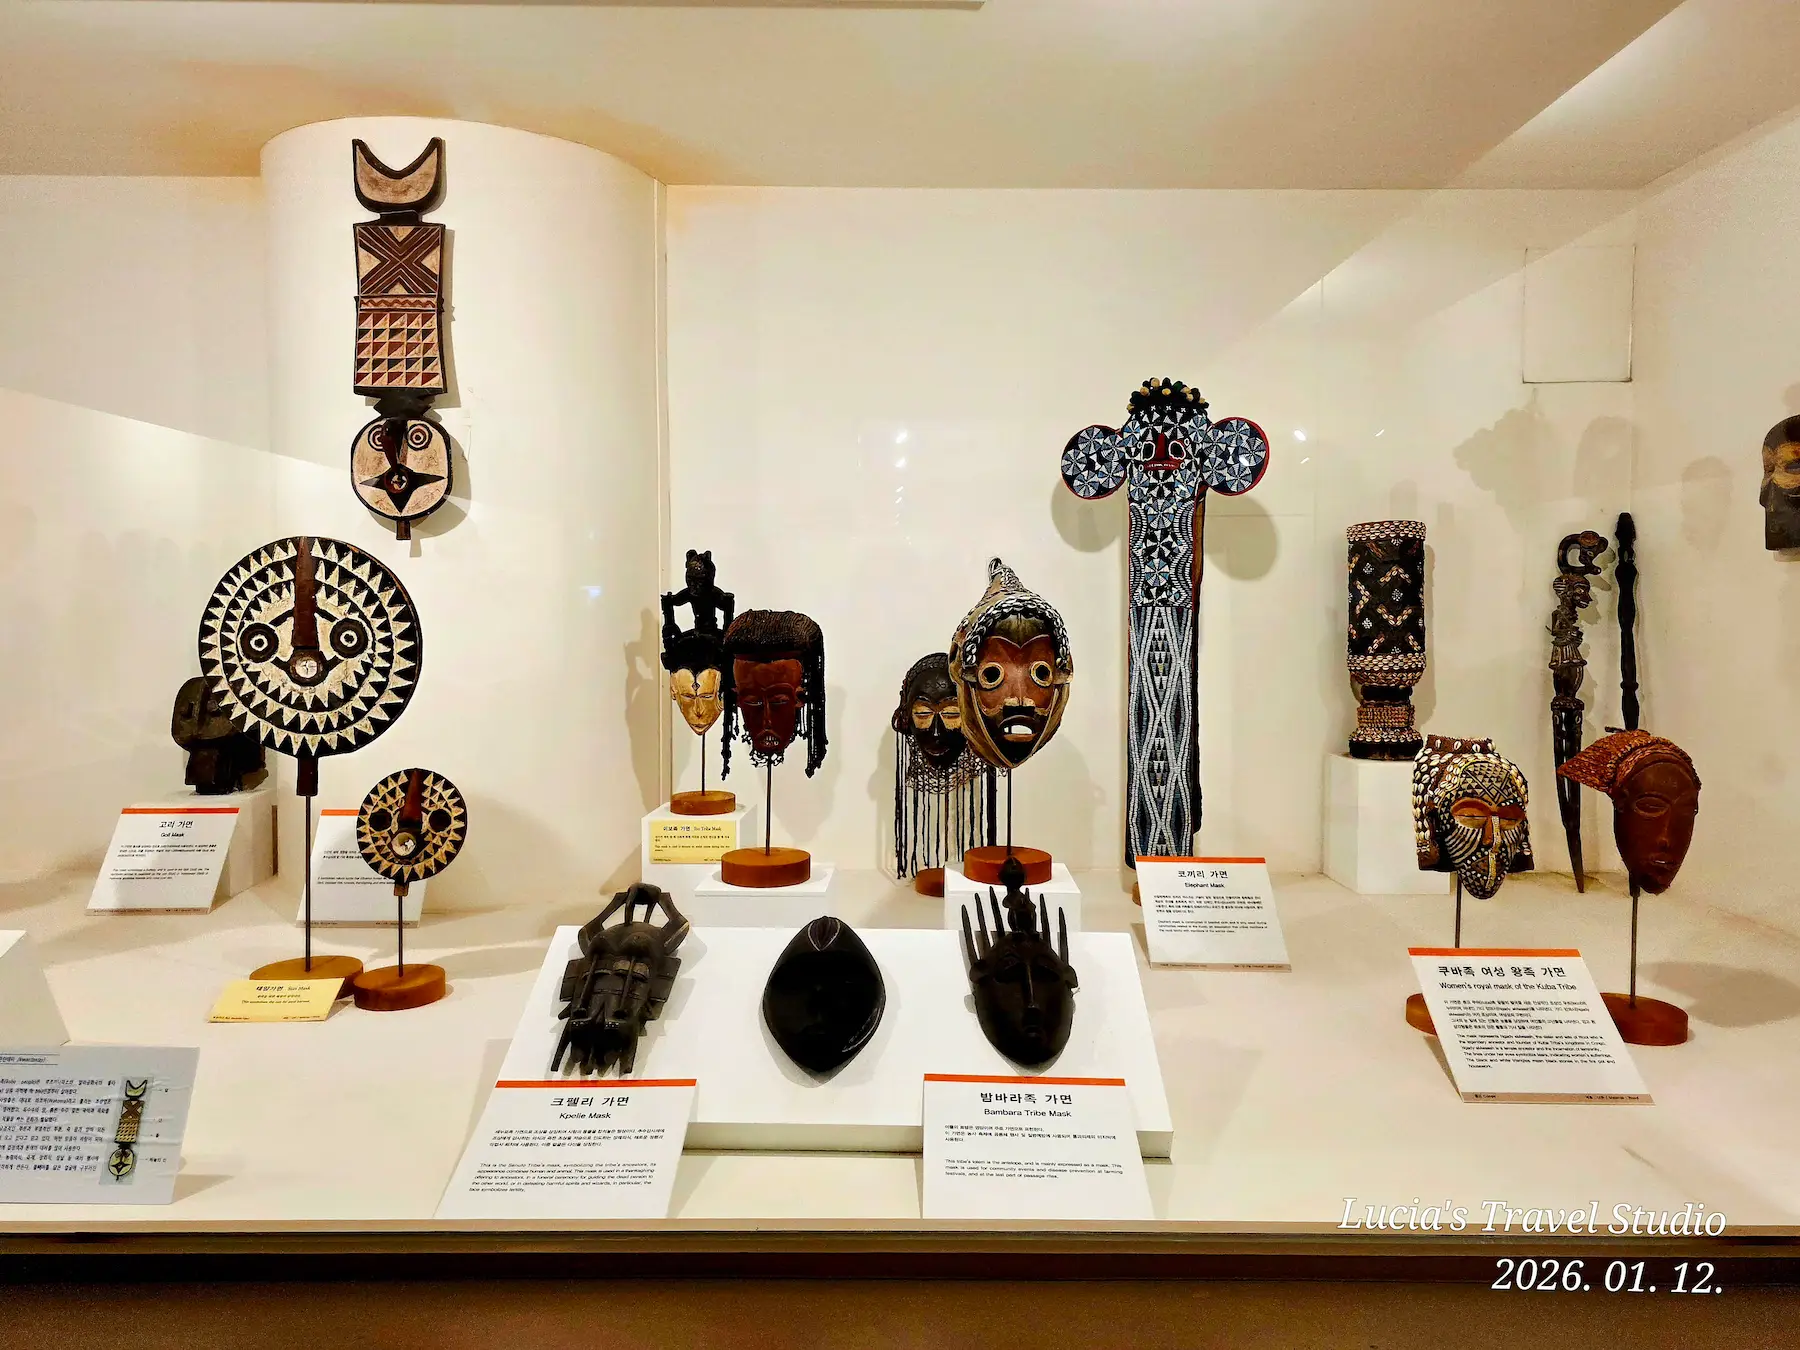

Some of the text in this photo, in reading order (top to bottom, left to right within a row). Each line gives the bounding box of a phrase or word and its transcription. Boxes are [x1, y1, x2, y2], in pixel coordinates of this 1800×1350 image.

[177, 820, 193, 828] 가면
[1178, 870, 1228, 878] 코끼리 가면
[1437, 966, 1566, 977] 쿠바족 여성 왕족 가면
[551, 1096, 629, 1106] 크펠리 가면
[980, 1092, 1072, 1104] 밤바라족 가면
